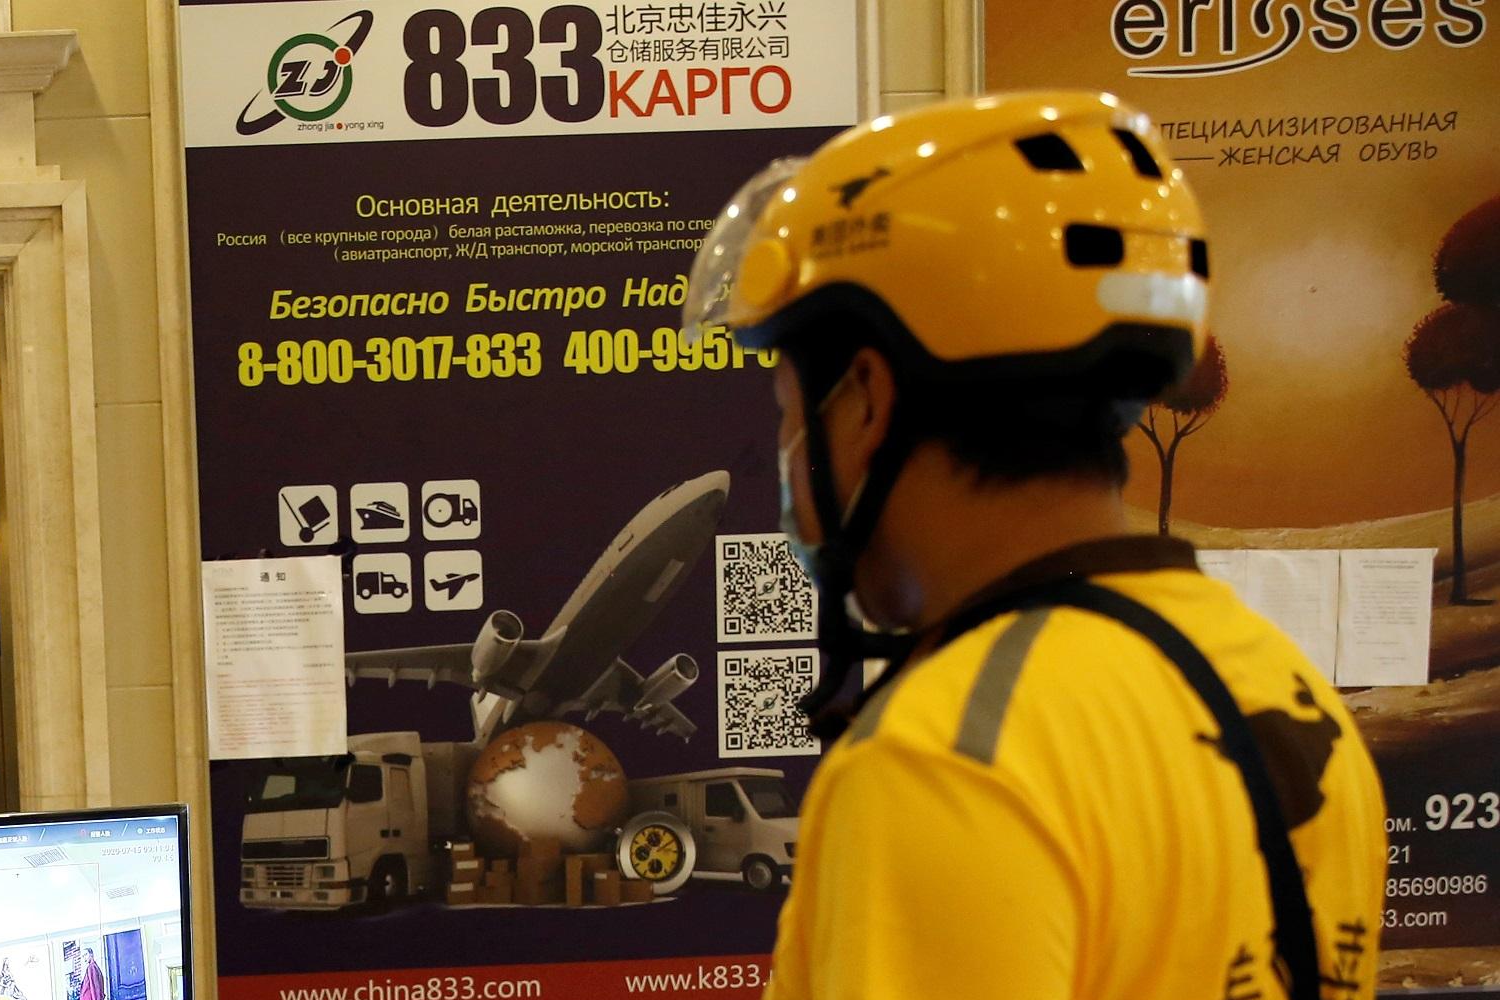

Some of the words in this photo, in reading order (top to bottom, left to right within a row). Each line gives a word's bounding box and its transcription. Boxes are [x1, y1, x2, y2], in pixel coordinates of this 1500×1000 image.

[606, 1, 787, 35] 北京忠佳永兴
[606, 35, 790, 64] 仓储服务有限公司
[402, 4, 605, 127] 833
[608, 65, 792, 118] КАРГО
[297, 122, 323, 133] zhong
[345, 121, 365, 132] yong
[367, 120, 384, 130] xing
[1359, 140, 1438, 162] ОБУВЬ
[356, 194, 479, 218] Основная
[491, 190, 669, 218] деятельность:
[217, 232, 267, 247] Россия
[315, 229, 377, 246] крупные
[449, 224, 491, 239] белая
[495, 221, 586, 240] растаможка,
[589, 220, 663, 237] перевозка
[668, 219, 684, 232] по
[456, 242, 489, 260] Ж/Д
[571, 238, 634, 255] морской
[270, 289, 449, 320] Безопасно
[466, 282, 606, 318] Быстро
[622, 274, 690, 308] Над
[238, 332, 542, 387] 8-800-3017-833
[1425, 791, 1500, 831] 923
[1385, 874, 1488, 898] 85690986
[625, 964, 772, 993] www.k833.
